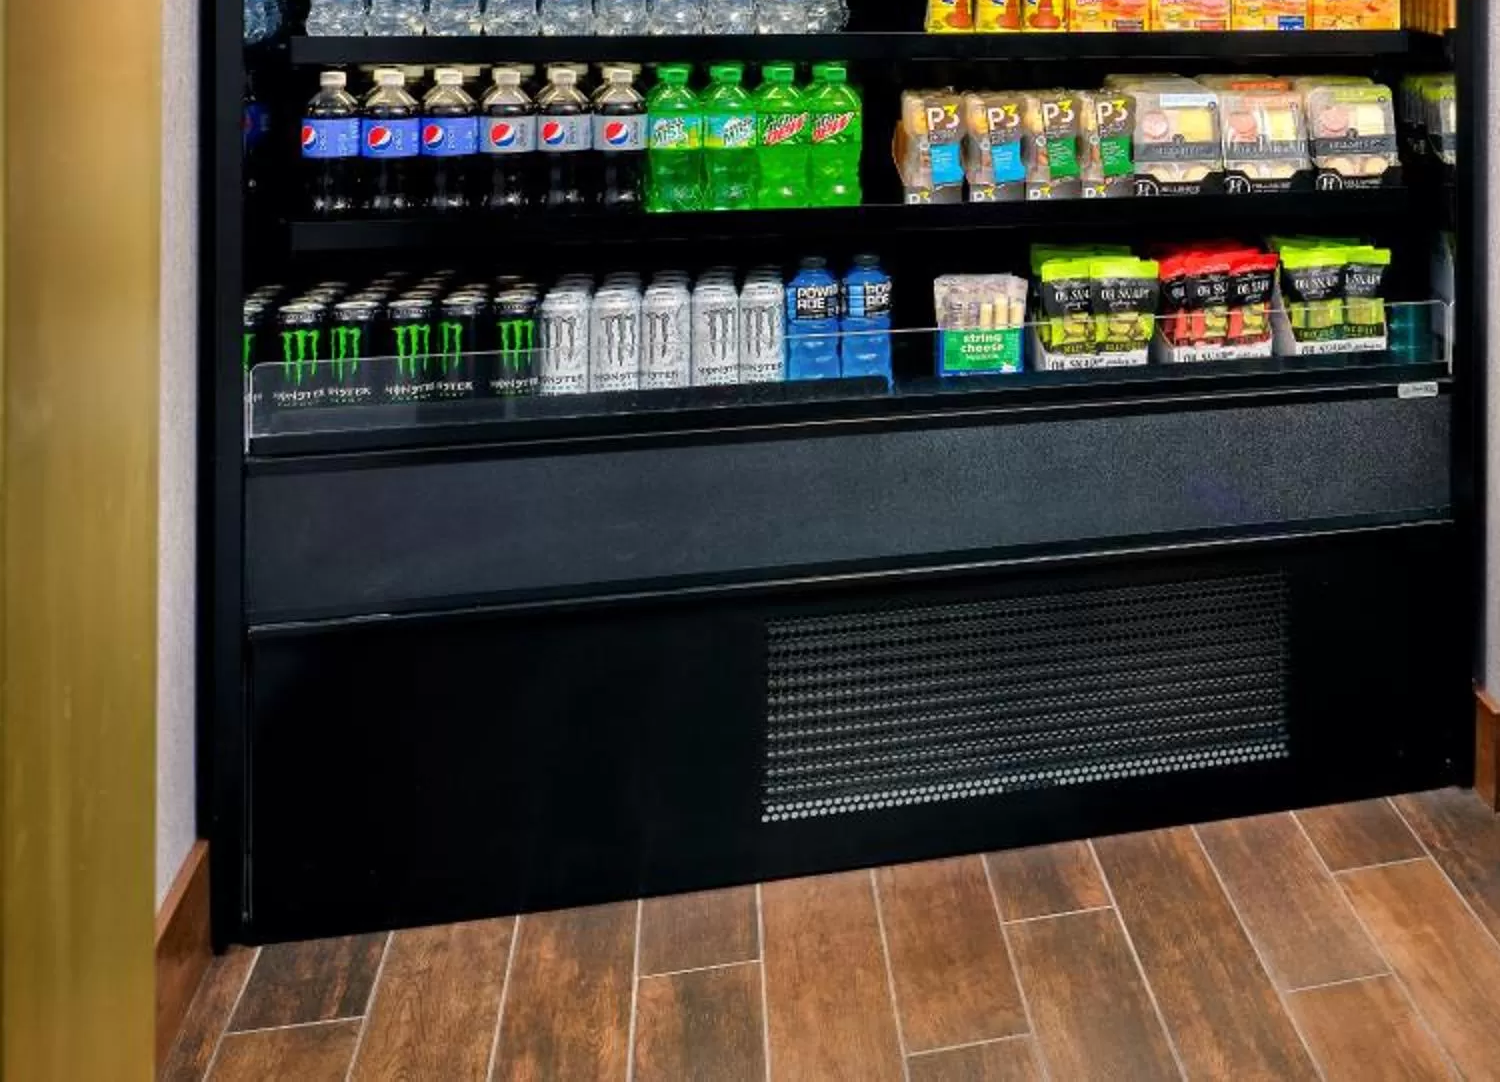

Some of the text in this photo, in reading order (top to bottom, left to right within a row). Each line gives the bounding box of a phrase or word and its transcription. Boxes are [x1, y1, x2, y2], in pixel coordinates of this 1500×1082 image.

[927, 103, 960, 131] P3
[987, 103, 1020, 131] P3
[1042, 98, 1075, 124] P3
[1096, 99, 1129, 124] P3
[960, 342, 1005, 354] cheese
[963, 332, 1002, 344] string
